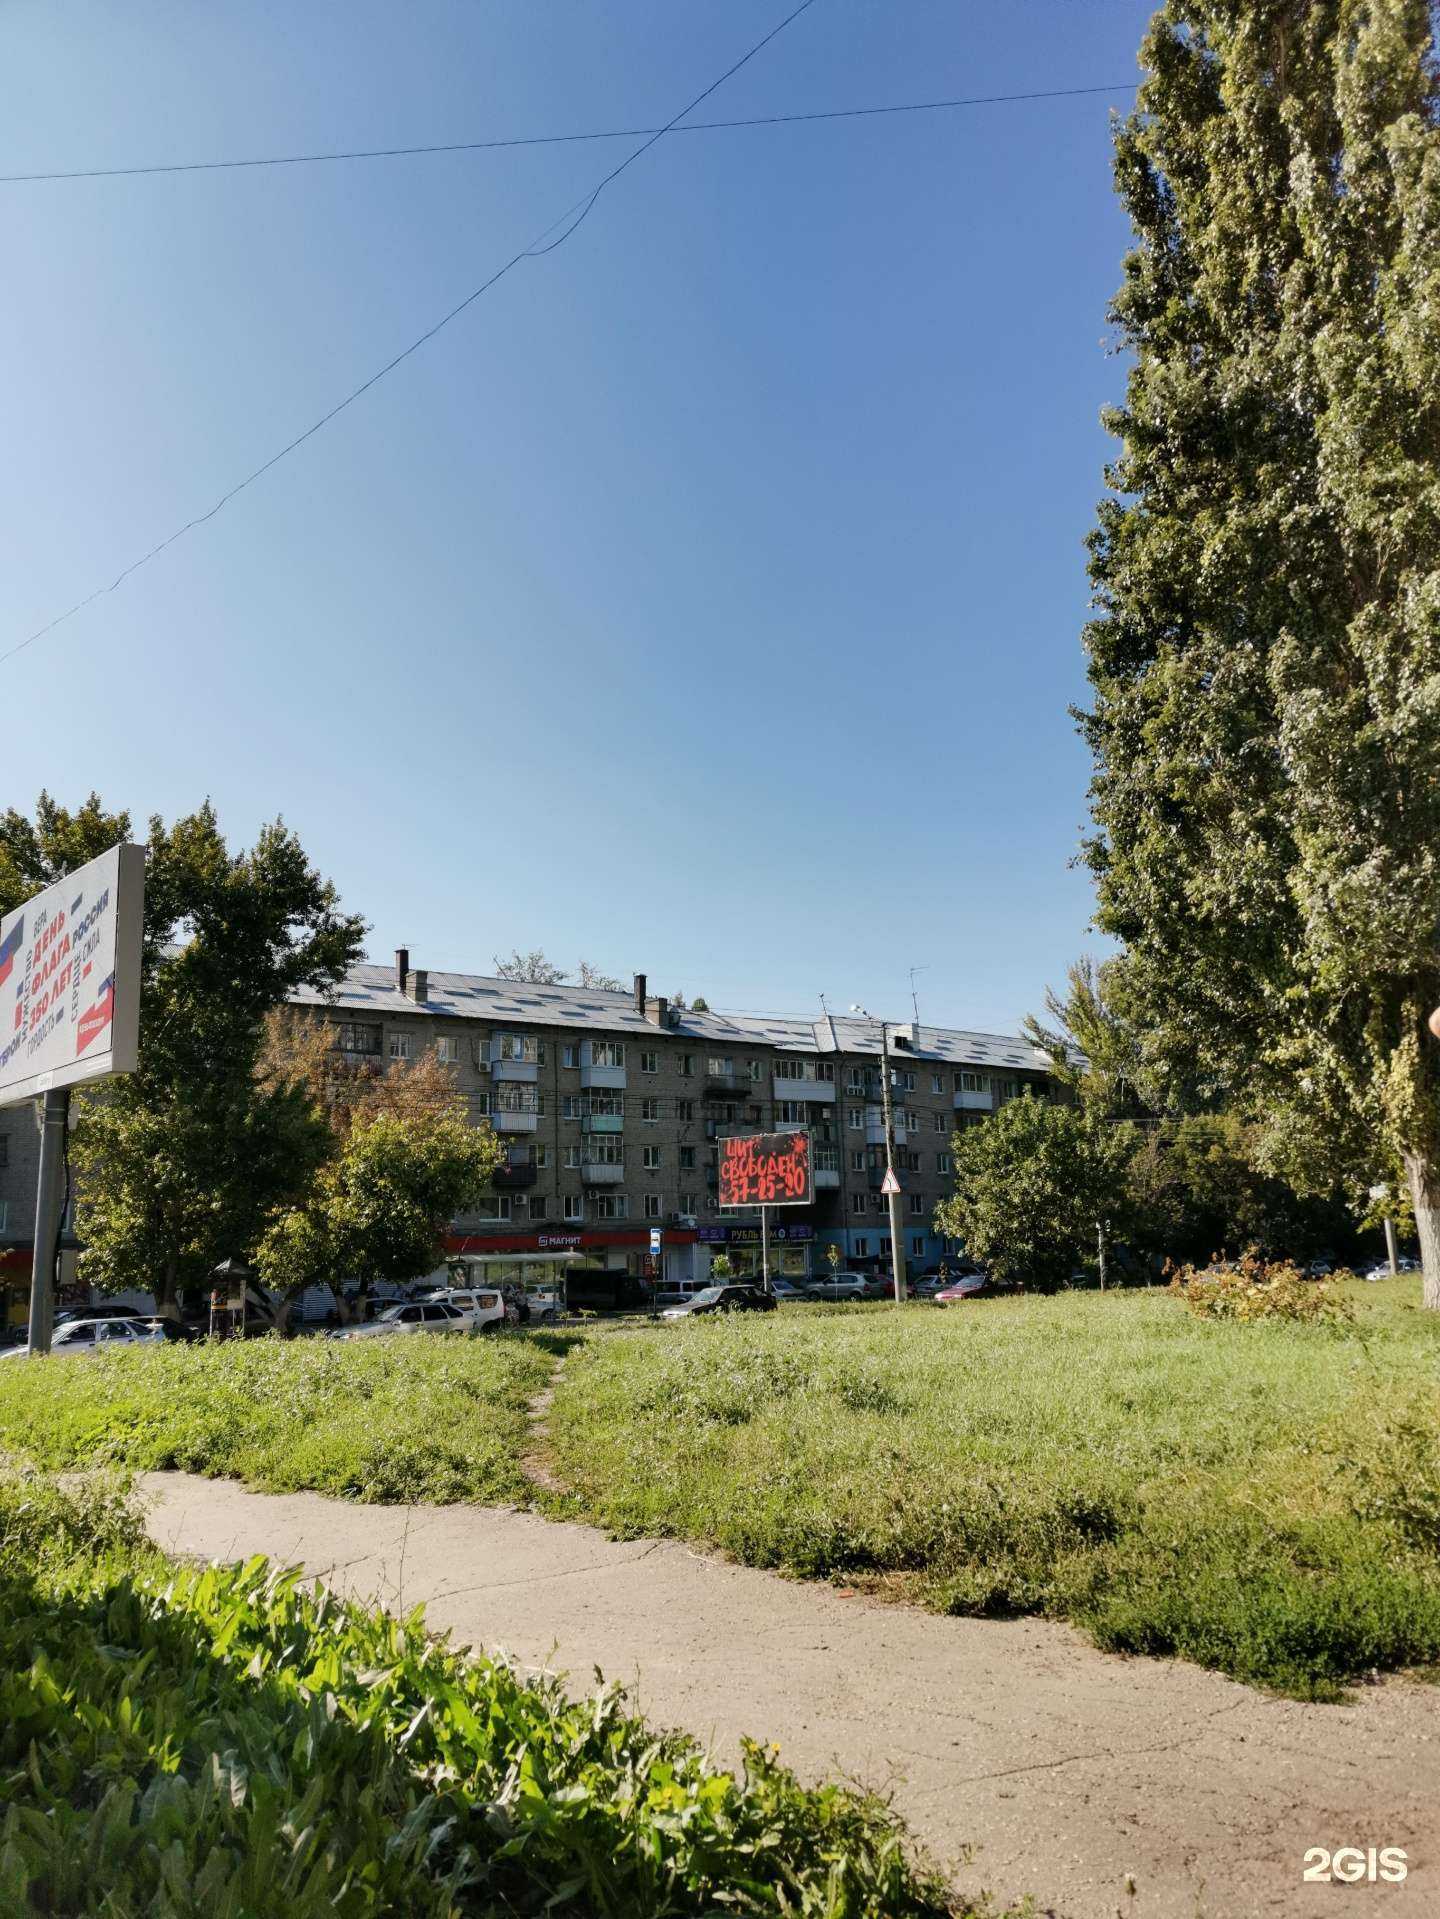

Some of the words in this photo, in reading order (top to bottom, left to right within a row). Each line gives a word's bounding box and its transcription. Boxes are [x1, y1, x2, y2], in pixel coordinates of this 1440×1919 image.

[33, 911, 65, 968] ДЕНЬ
[83, 927, 100, 961] СИЛА
[32, 933, 70, 995] ФЛАГА
[29, 991, 49, 1031] 350
[51, 959, 73, 1005] ЛЕТ
[722, 1153, 796, 1180] СВОБОДЕН
[549, 1236, 582, 1246] МАГНИТ
